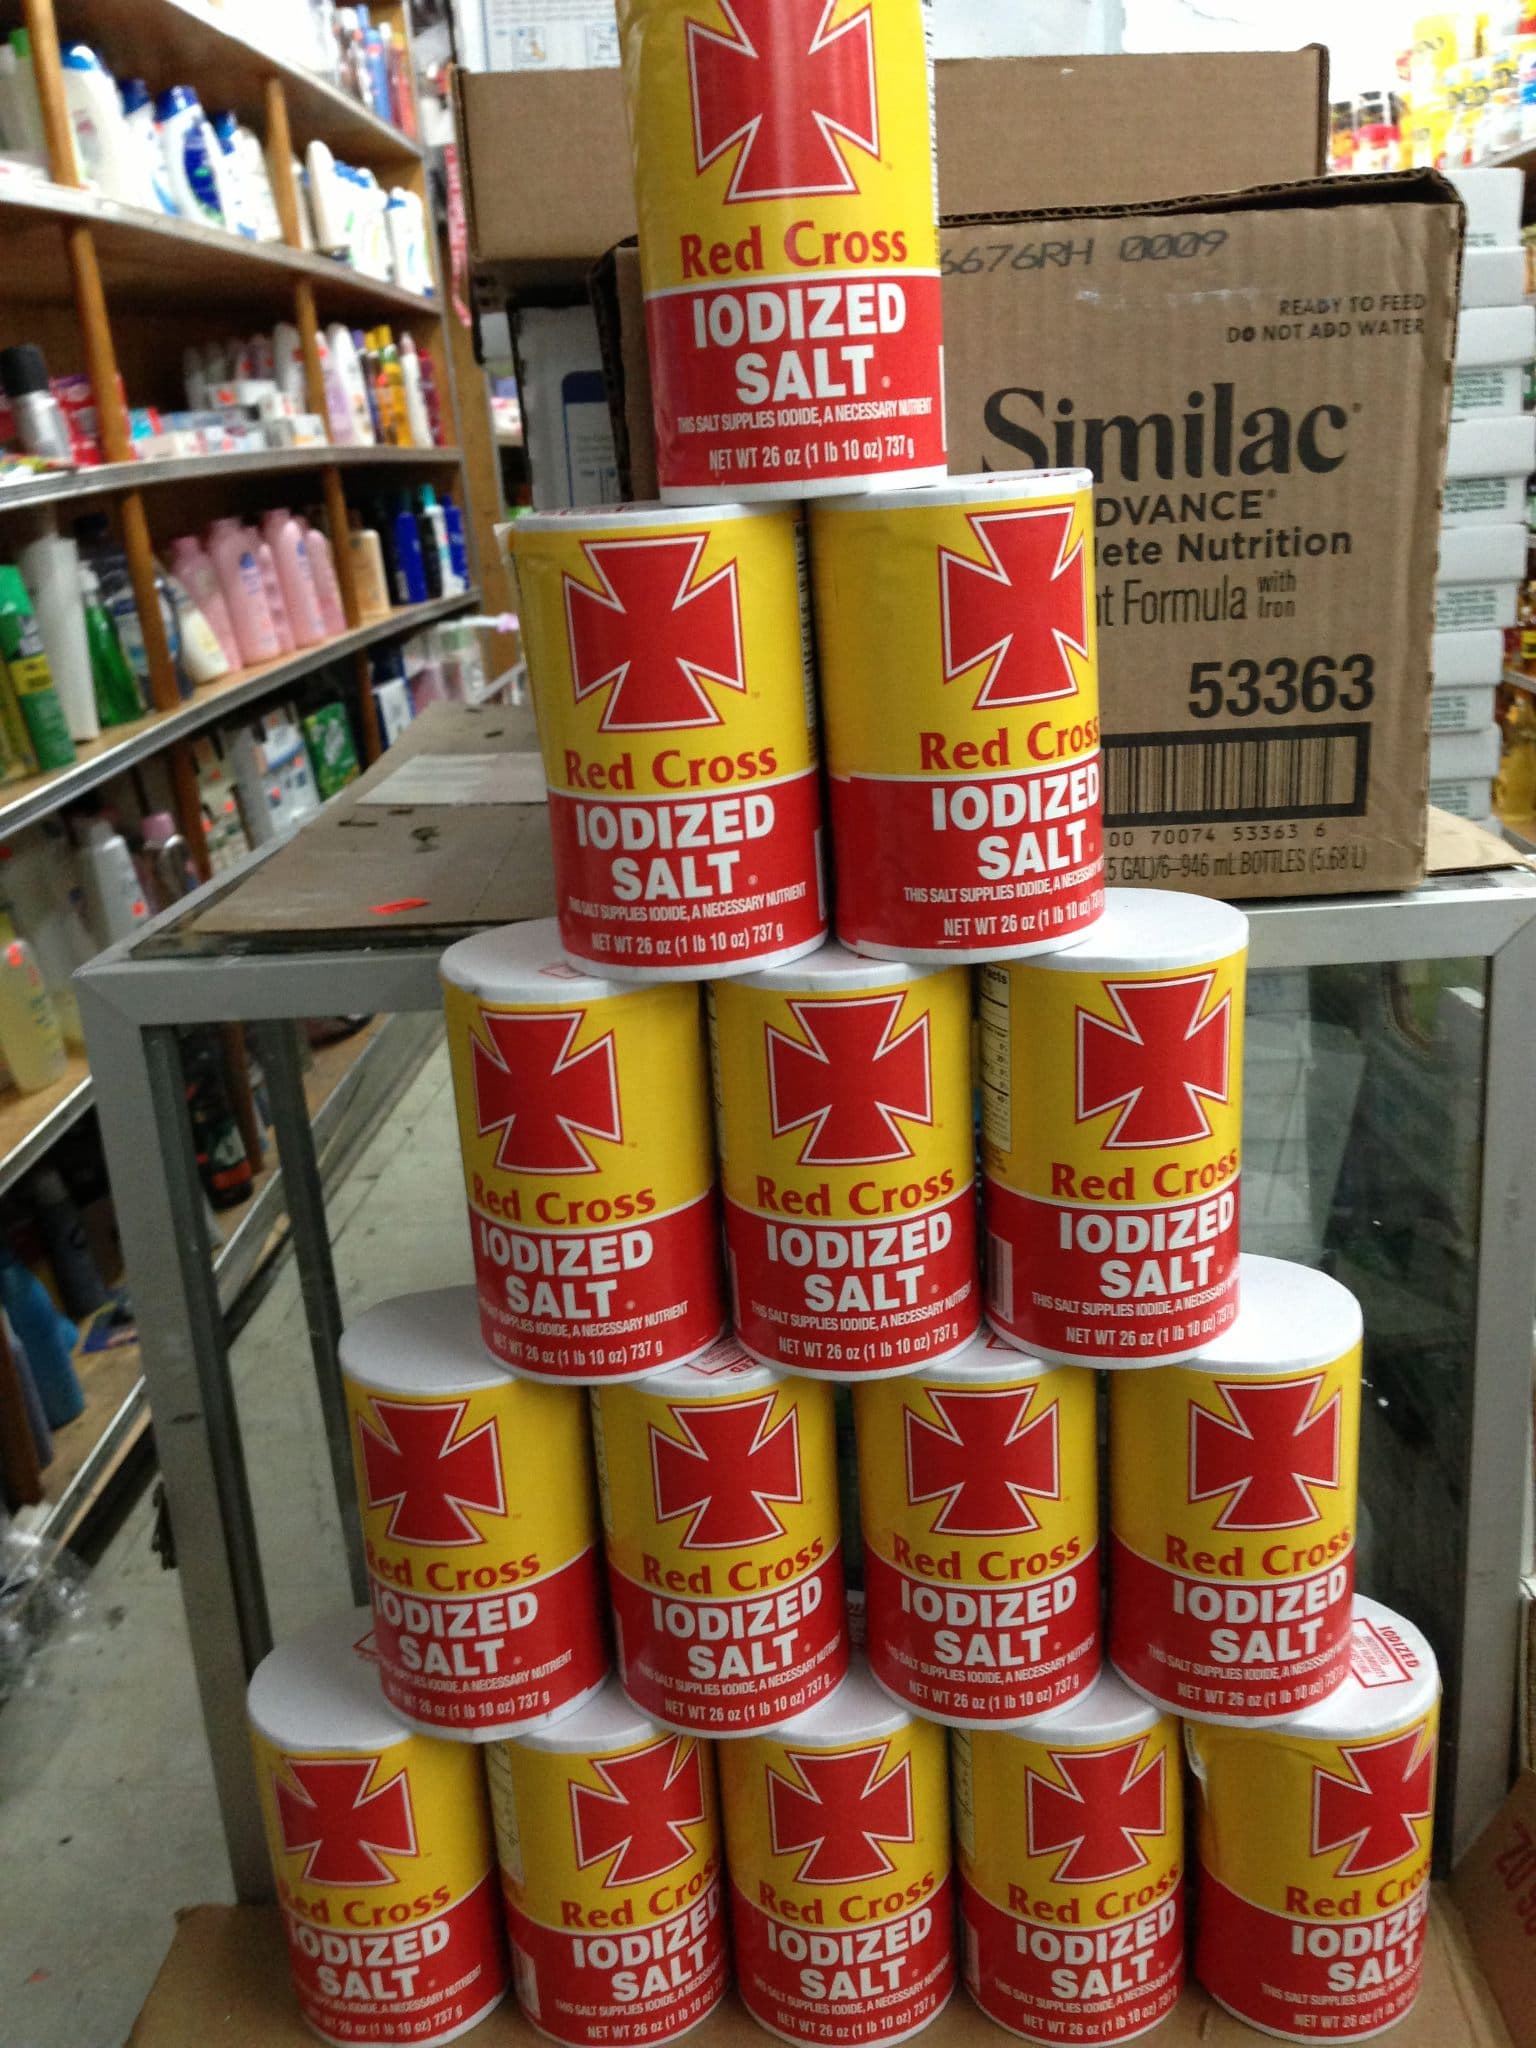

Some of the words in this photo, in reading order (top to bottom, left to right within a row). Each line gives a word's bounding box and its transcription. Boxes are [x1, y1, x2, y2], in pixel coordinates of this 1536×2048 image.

[681, 225, 764, 279] Red
[783, 221, 908, 267] Cross
[693, 283, 906, 349] IODIZED
[1280, 297, 1341, 316] READY
[1351, 296, 1374, 313] TO
[1381, 293, 1425, 311] FEED
[1227, 326, 1255, 343] DO
[1263, 324, 1304, 341] NOT
[1309, 322, 1350, 339] ADD
[1359, 318, 1425, 336] WATER
[736, 344, 874, 405] SALT
[696, 414, 719, 432] SALT
[721, 410, 775, 431] SUPPLIES
[823, 405, 833, 423] A
[835, 400, 898, 422] NECESSARY
[983, 382, 1348, 483] Similac
[709, 449, 731, 470] NET
[736, 447, 758, 469] WT
[762, 446, 780, 468] 26
[785, 449, 801, 466] oz
[805, 442, 818, 469] (1
[825, 441, 838, 462] lb
[842, 439, 859, 461] 10
[863, 436, 882, 462] oz)
[885, 435, 905, 456] 737
[907, 438, 914, 459] g
[1095, 489, 1263, 527] DVANCE
[1178, 527, 1353, 562] Nutrition
[1125, 574, 1248, 624] Formula
[1257, 570, 1296, 592] with
[1258, 597, 1295, 618] Iron
[1188, 653, 1375, 719] 53363
[564, 748, 634, 790] Red
[652, 747, 777, 789] Cross
[920, 728, 1010, 770] Red
[932, 762, 1099, 831] IODIZED
[576, 794, 775, 850] IODIZED
[1151, 828, 1216, 845] 70074
[1233, 824, 1298, 841] 53363
[1315, 822, 1325, 837] 6
[977, 819, 1086, 880] SALT
[1242, 848, 1305, 874] BOTTLES
[611, 850, 740, 901] SALT
[600, 904, 647, 921] SUPPLIES
[692, 904, 701, 919] A
[703, 894, 765, 918] NECESSARY
[767, 881, 806, 907] NUTRIENT
[592, 932, 611, 951] NET
[614, 936, 633, 953] WT
[636, 936, 652, 954] 26
[656, 940, 671, 954] oz
[675, 936, 687, 957] (1
[693, 935, 706, 952] lb
[710, 932, 726, 950] 10
[731, 928, 749, 949] oz)
[752, 922, 773, 943] 737
[776, 923, 783, 941] g
[756, 1175, 831, 1216] Red
[849, 1169, 954, 1216] Cross
[1051, 1162, 1135, 1200] Red
[1153, 1149, 1237, 1198] Cross
[473, 1174, 522, 1222] Red
[536, 1188, 656, 1225] Cross
[1060, 1191, 1234, 1253] IODIZED
[480, 1221, 653, 1277] IODIZED
[766, 1211, 952, 1268] IODIZED
[804, 1265, 924, 1312] SALT
[1100, 1246, 1215, 1298] SALT
[506, 1275, 618, 1319] SALT
[768, 1307, 789, 1324] SALT
[791, 1314, 838, 1331] SUPPLIES
[881, 1316, 888, 1328] A
[891, 1300, 944, 1327] NECESSARY
[780, 1336, 799, 1355] NET
[803, 1341, 822, 1358] WT
[827, 1344, 841, 1360] 26
[846, 1348, 860, 1360] oz
[864, 1344, 875, 1362] (1
[881, 1342, 892, 1357] lb
[896, 1338, 910, 1354] 10
[914, 1332, 930, 1351] oz)
[932, 1323, 950, 1344] 737
[953, 1323, 958, 1338] g
[426, 1554, 541, 1592] Cross
[643, 1553, 712, 1594] Red
[728, 1537, 824, 1591] Cross
[894, 1533, 961, 1580] Red
[978, 1536, 1080, 1581] Cross
[1165, 1534, 1244, 1576] Red
[1262, 1528, 1350, 1575] Cross
[374, 1583, 538, 1638] IODIZED
[653, 1576, 822, 1640] IODIZED
[901, 1575, 1077, 1628] IODIZED
[1173, 1565, 1347, 1624] IODIZED
[400, 1635, 505, 1676] SALT
[688, 1628, 799, 1679] SALT
[934, 1625, 1049, 1667] SALT
[1210, 1617, 1324, 1664] SALT
[1378, 1626, 1421, 1668] IODIZED
[665, 1698, 685, 1717] NET
[688, 1704, 706, 1720] WT
[710, 1707, 724, 1721] 26
[728, 1710, 741, 1721] oz
[744, 1705, 755, 1721] (1
[760, 1702, 770, 1715] lb
[774, 1696, 787, 1712] 10
[790, 1688, 804, 1706] oz)
[808, 1675, 822, 1697] 737
[344, 1885, 450, 1927] Cross
[562, 1899, 634, 1928] Red
[648, 1859, 714, 1916] Cro
[759, 1879, 824, 1924] Red
[839, 1872, 935, 1922] Cross
[1008, 1883, 1080, 1924] Red
[1286, 1886, 1361, 1917] Red
[1376, 1860, 1430, 1907] Cro
[768, 1908, 932, 1966] IODIZED
[1017, 1899, 1176, 1965] IODIZED
[317, 1965, 420, 2000] SALT
[611, 1936, 707, 2001] SALT
[800, 1956, 906, 2000] SALT
[1052, 1949, 1154, 1999] SALT
[1328, 1931, 1418, 1992] SALT
